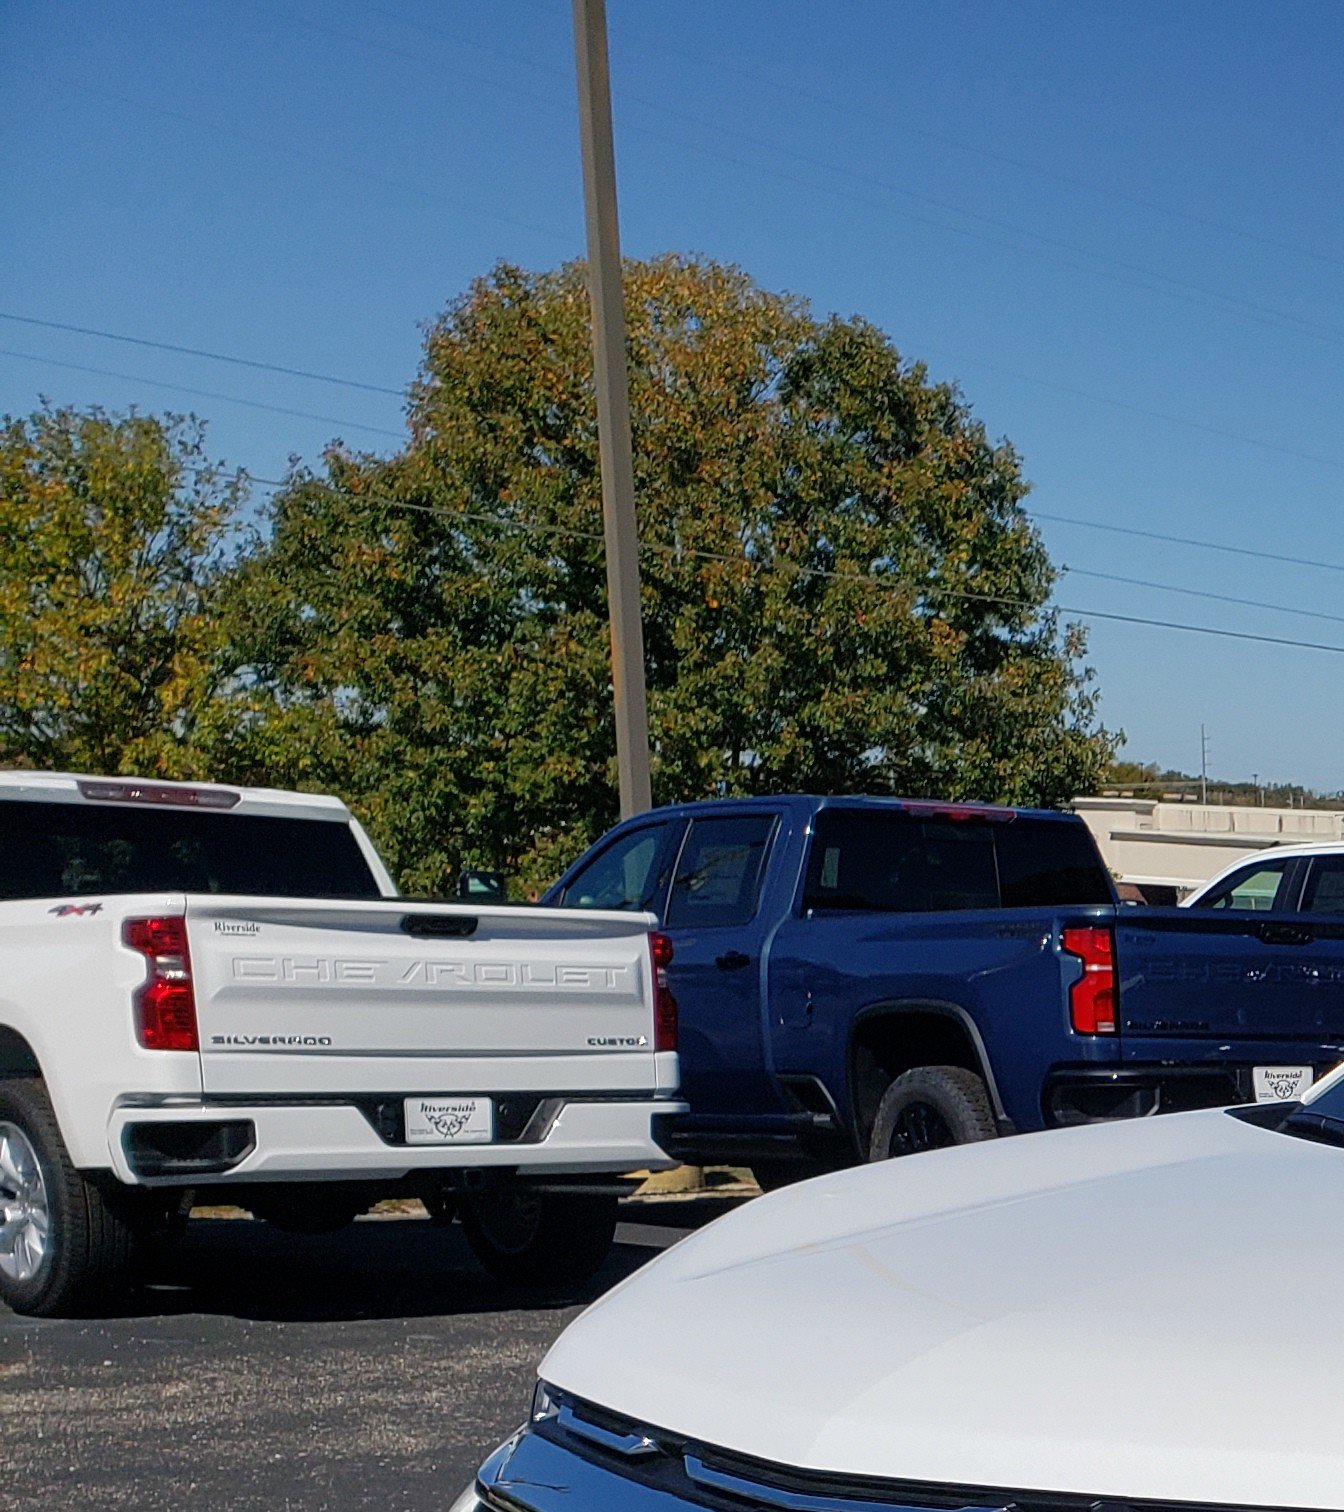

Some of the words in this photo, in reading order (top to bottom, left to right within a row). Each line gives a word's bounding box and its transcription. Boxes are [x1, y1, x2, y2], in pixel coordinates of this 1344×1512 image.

[214, 921, 261, 932] Riverside
[211, 1035, 332, 1046] SILVERADO
[420, 1101, 477, 1113] Riverside
